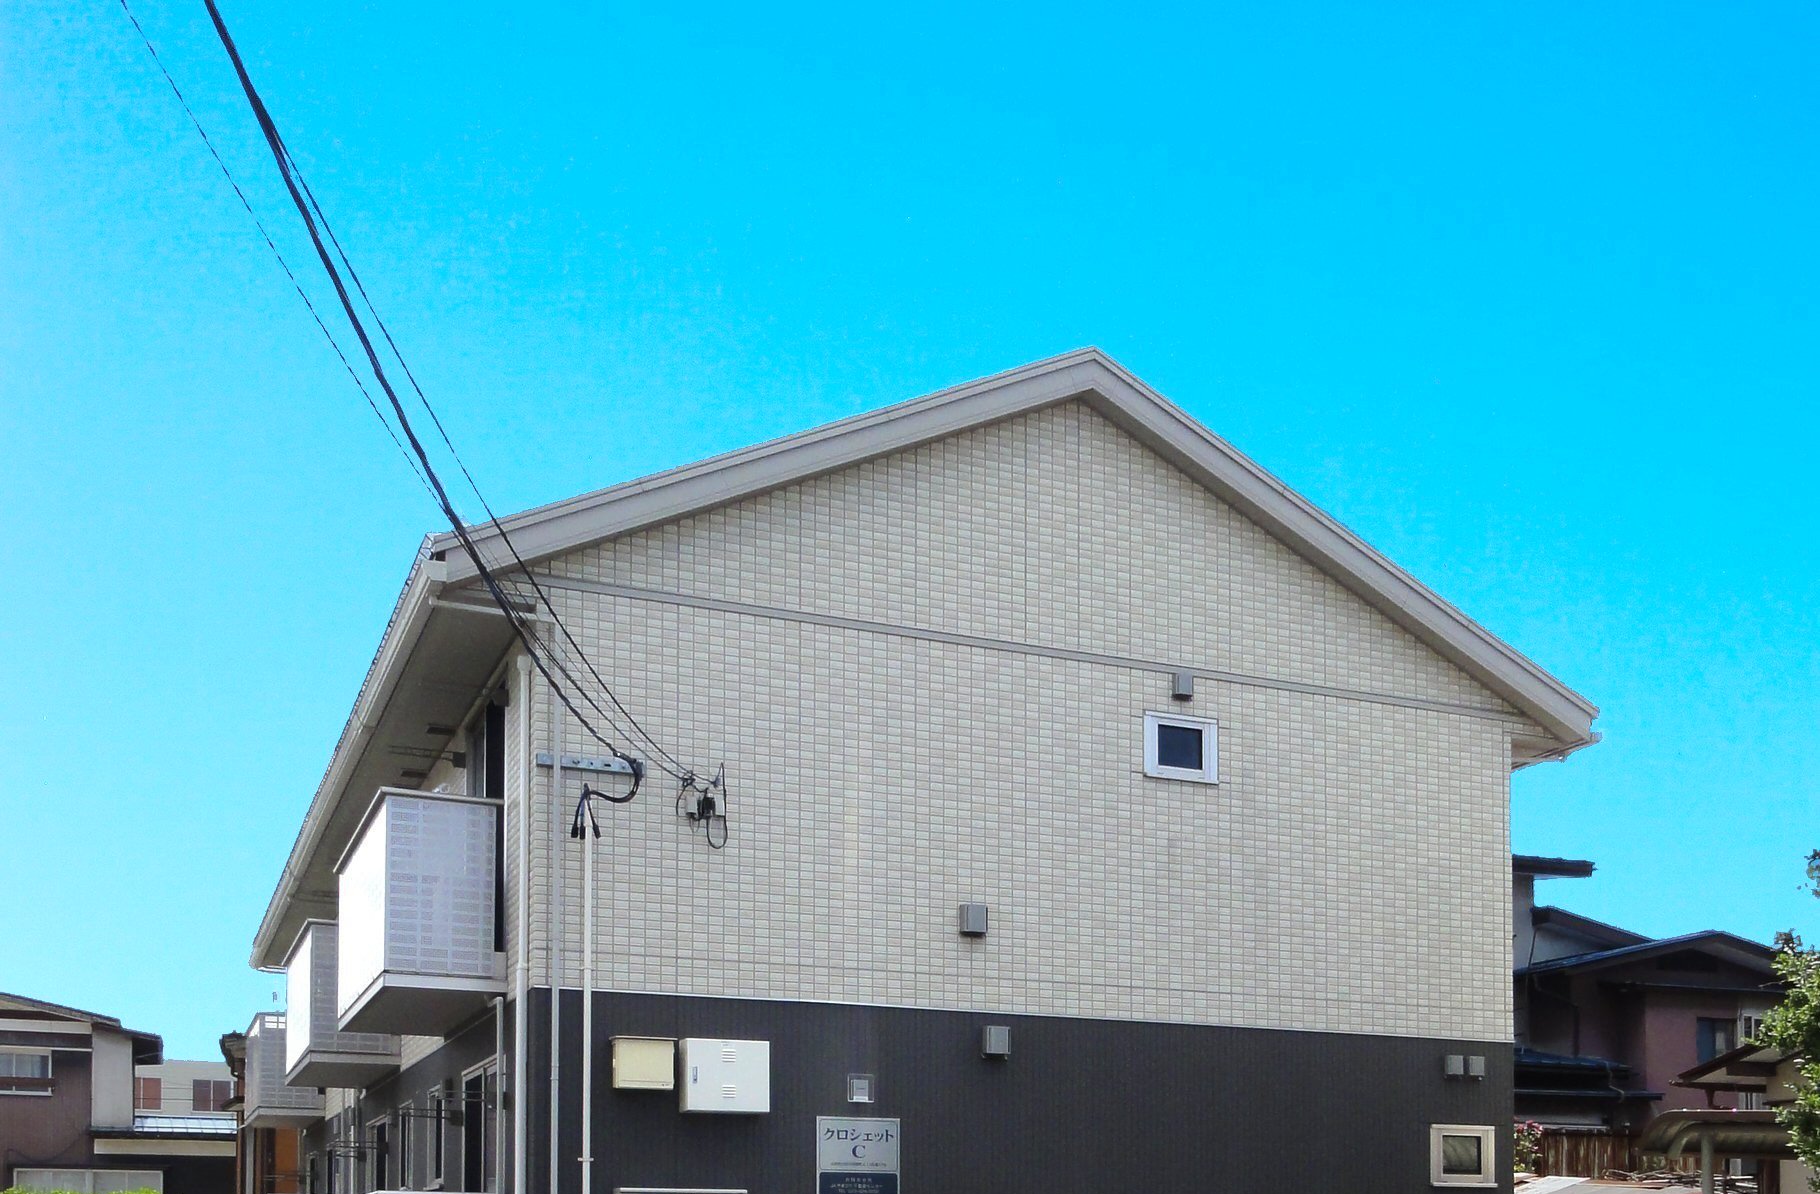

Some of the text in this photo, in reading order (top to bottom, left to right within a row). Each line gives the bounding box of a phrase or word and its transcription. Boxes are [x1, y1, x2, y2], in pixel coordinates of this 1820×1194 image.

[824, 1127, 894, 1143] クロシェット
[851, 1144, 866, 1159] C
